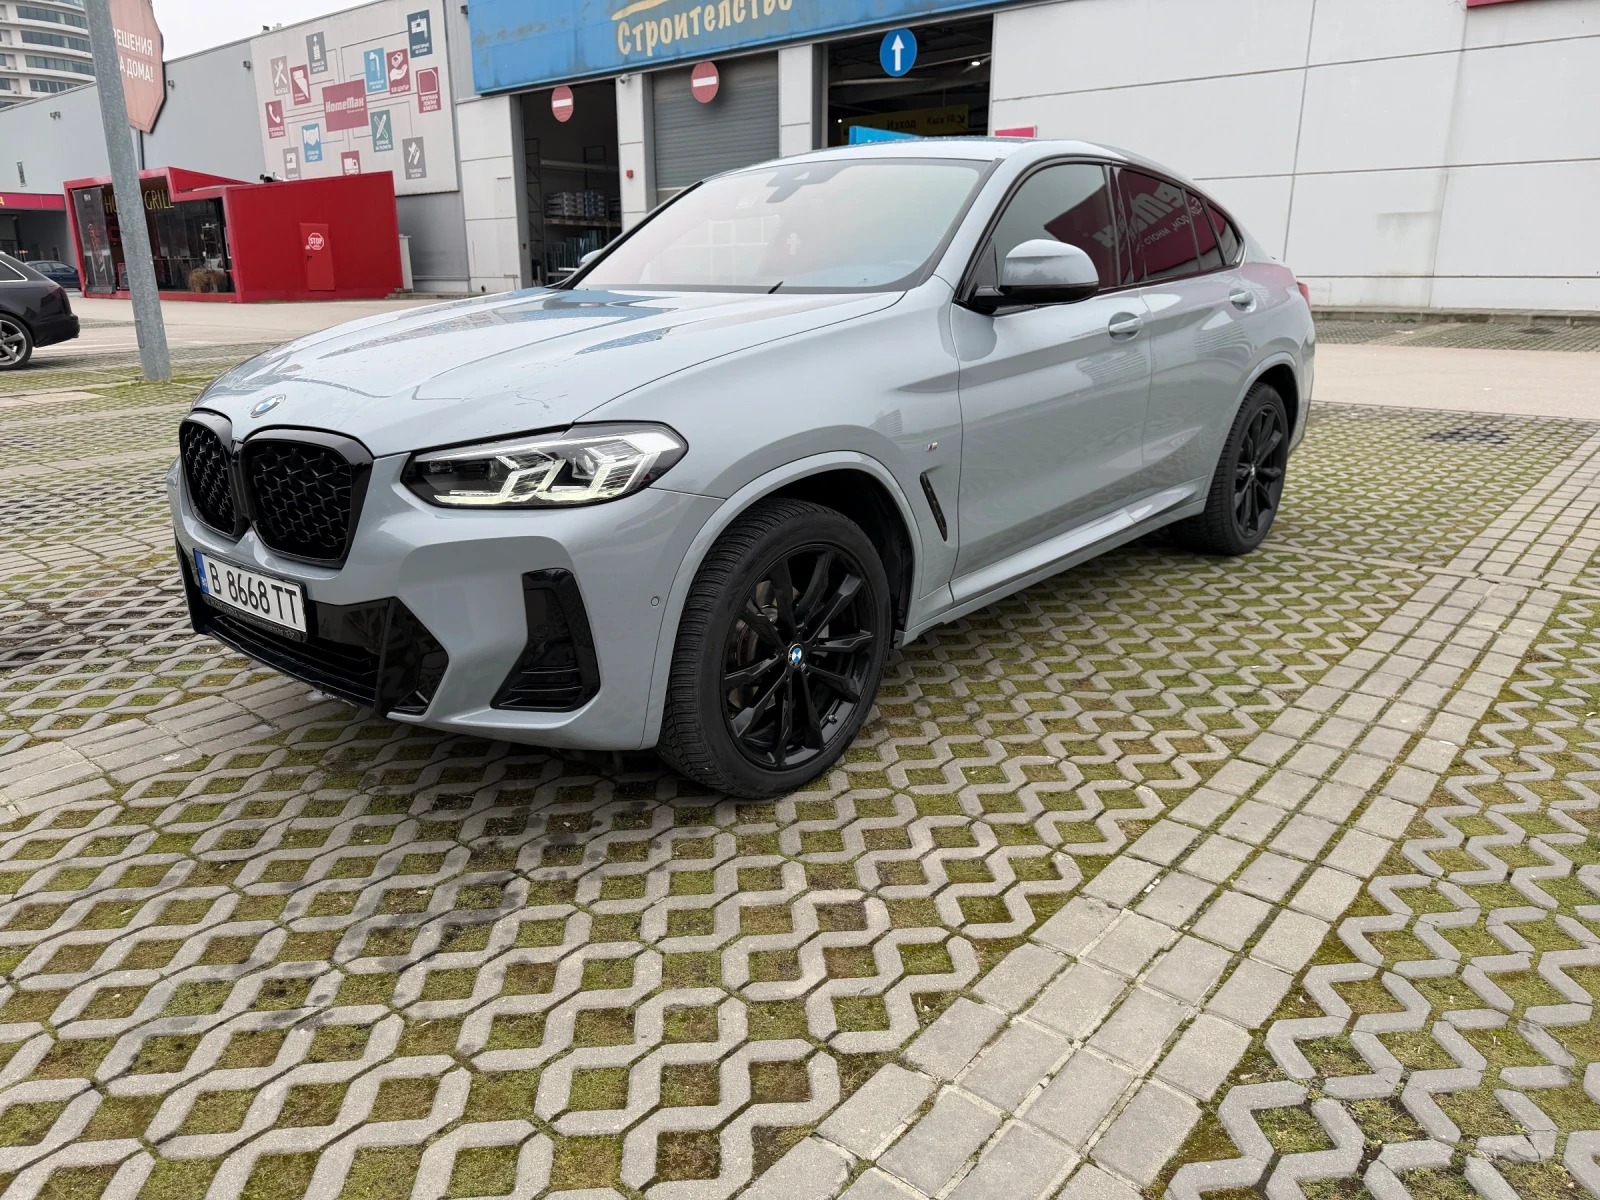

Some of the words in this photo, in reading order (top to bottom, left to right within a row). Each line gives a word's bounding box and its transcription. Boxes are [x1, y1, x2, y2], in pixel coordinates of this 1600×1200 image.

[127, 58, 153, 83] ДОМА!
[325, 97, 364, 112] HomeMax
[887, 119, 916, 131] Изход
[144, 190, 174, 210] GRILL
[310, 237, 323, 245] STOP
[208, 561, 221, 595] B
[226, 570, 271, 614] 8668
[270, 583, 297, 624] TT
